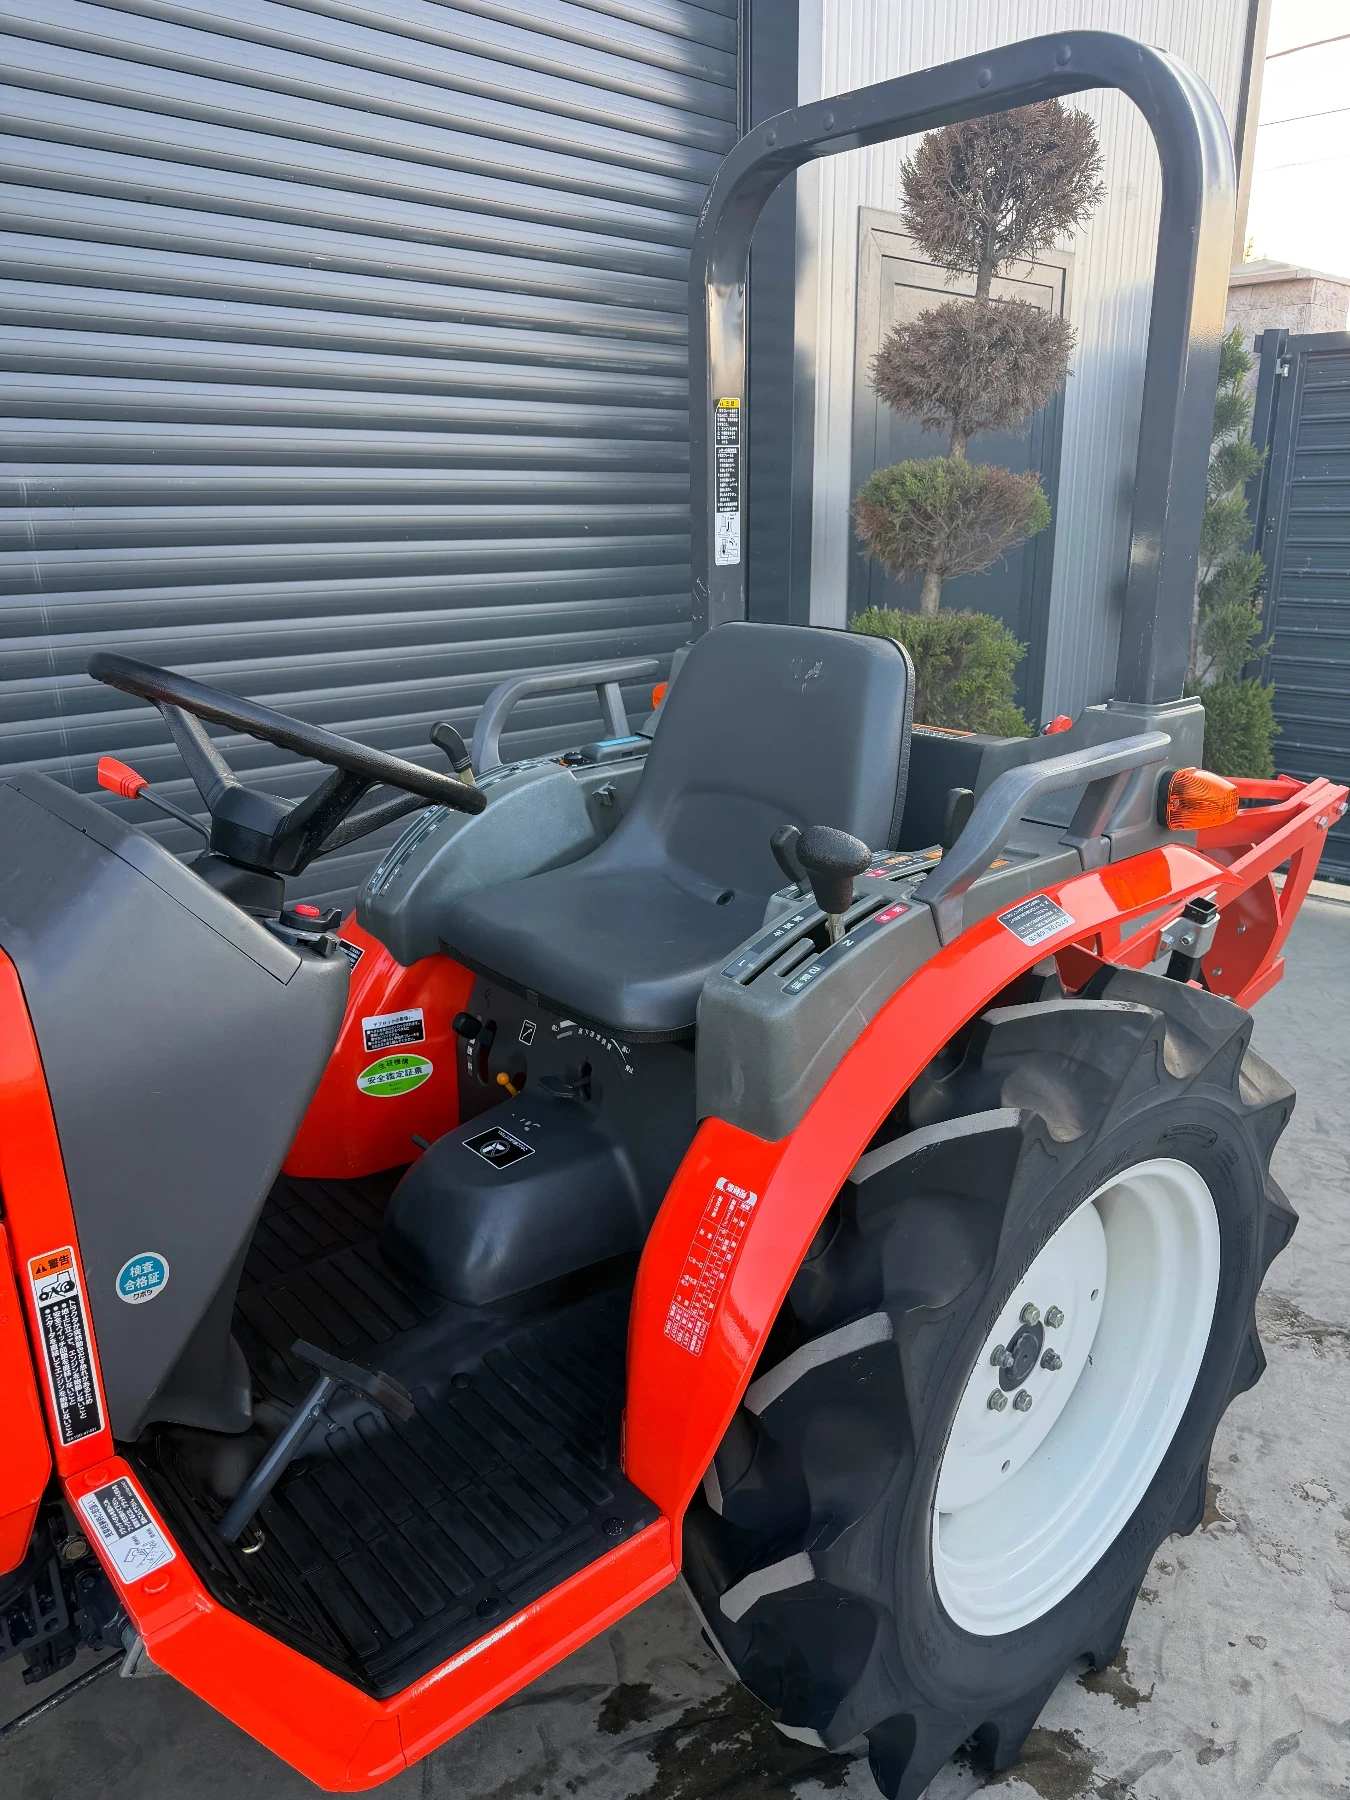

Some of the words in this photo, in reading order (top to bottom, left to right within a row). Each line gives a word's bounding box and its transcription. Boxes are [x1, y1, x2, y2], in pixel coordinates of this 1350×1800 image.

[368, 1066, 422, 1084] 安全鑑定証票
[48, 1255, 69, 1269] 警告
[130, 1261, 154, 1277] 検査
[124, 1271, 160, 1291] 合格証
[133, 1290, 153, 1300] クボタ
